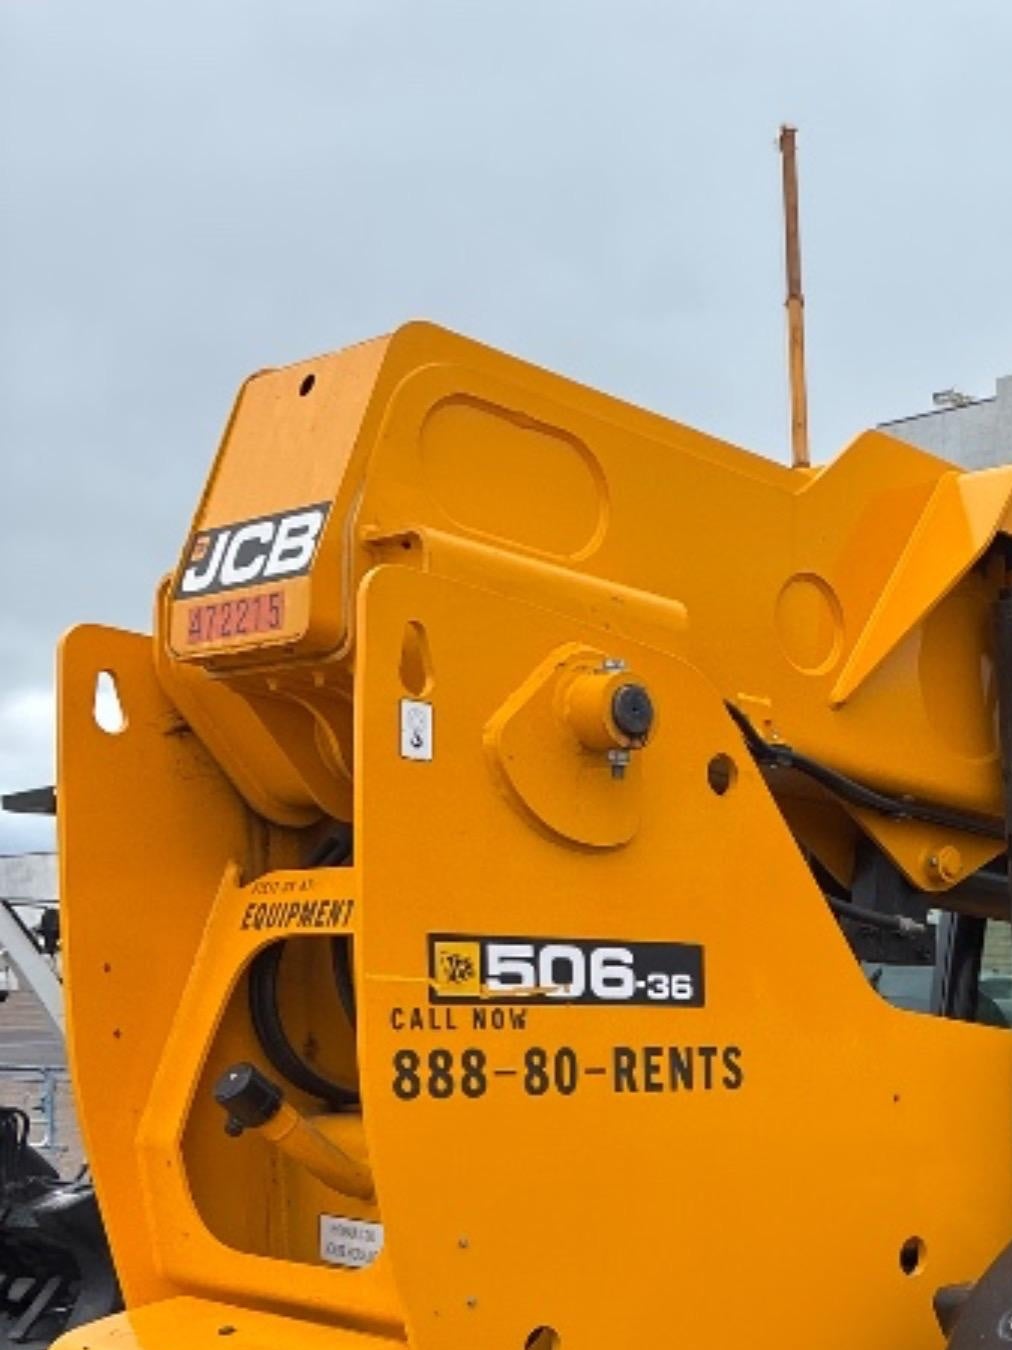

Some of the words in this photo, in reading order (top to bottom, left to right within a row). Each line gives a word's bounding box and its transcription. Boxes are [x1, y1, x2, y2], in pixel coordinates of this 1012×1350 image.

[181, 510, 325, 592] JCB
[240, 900, 354, 930] EQUIPMENT
[484, 943, 693, 999] 506-36
[390, 1007, 457, 1031] CALL
[472, 1007, 527, 1030] NOW
[392, 1046, 744, 1101] 888-80-RENTS
